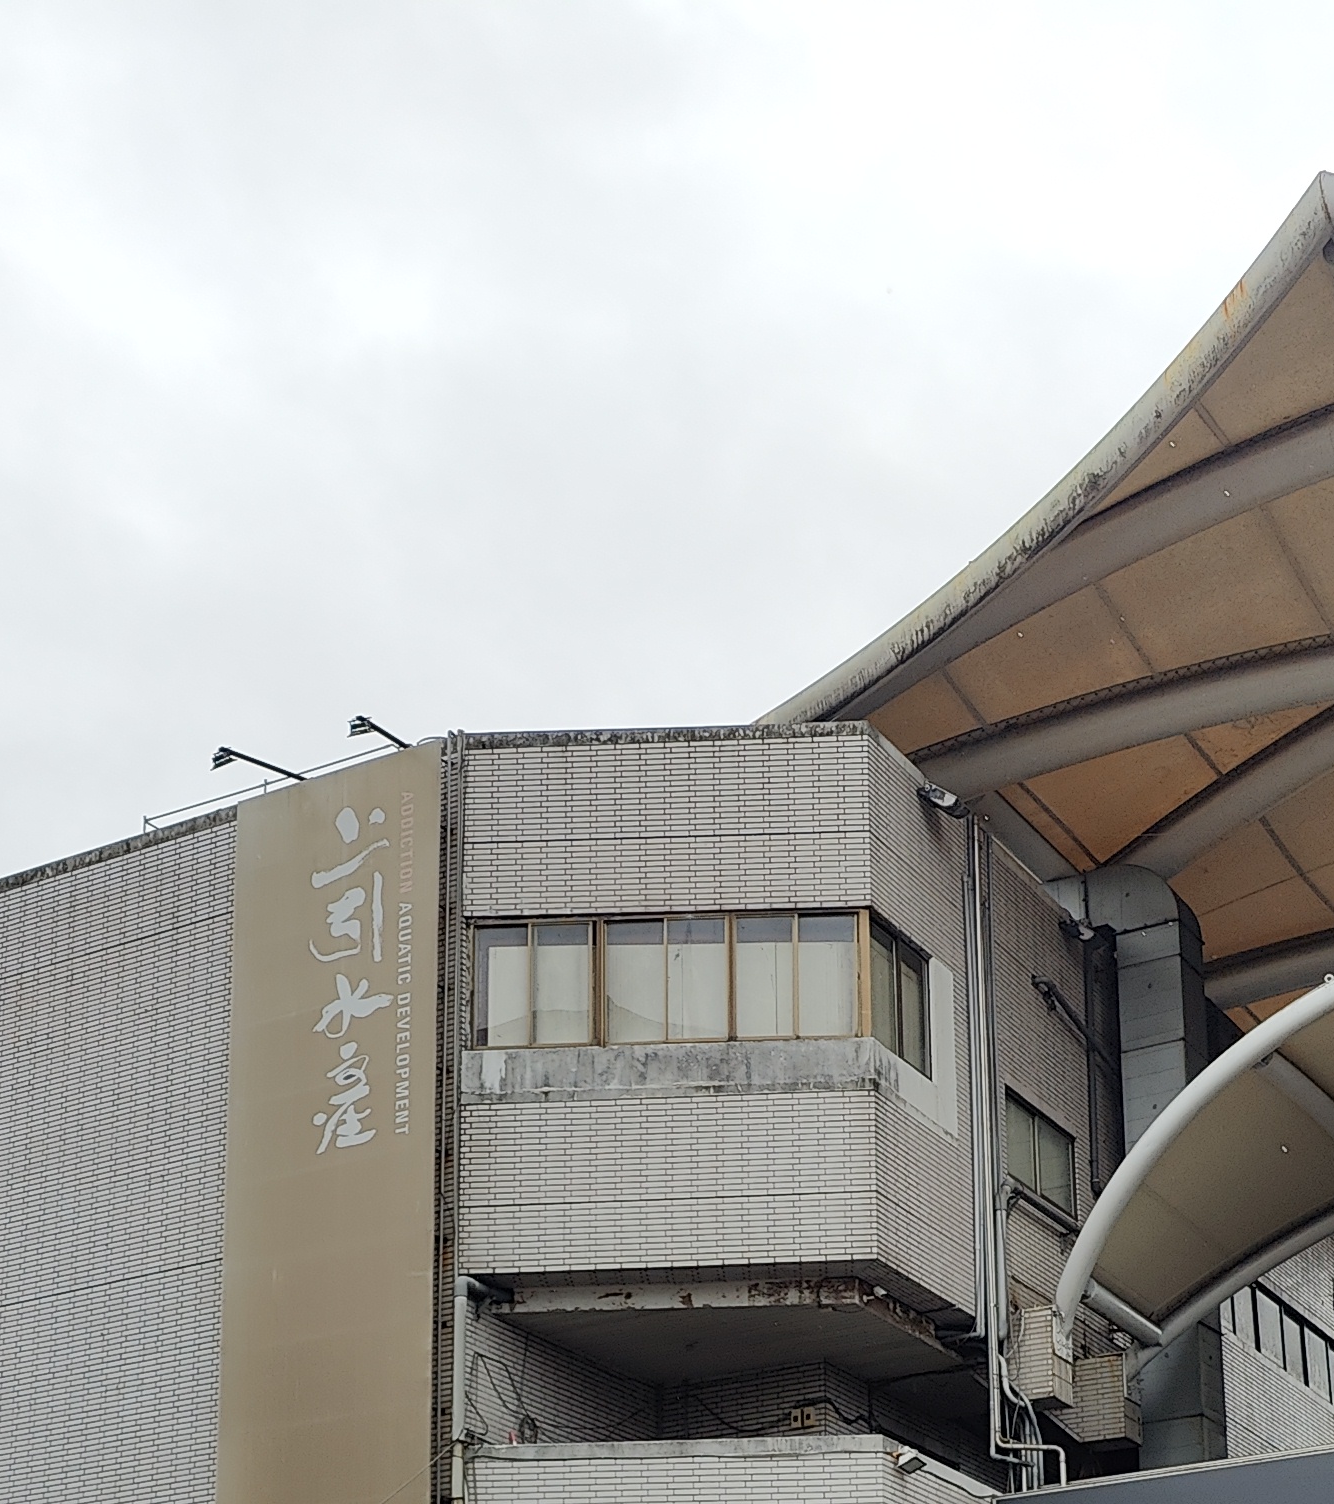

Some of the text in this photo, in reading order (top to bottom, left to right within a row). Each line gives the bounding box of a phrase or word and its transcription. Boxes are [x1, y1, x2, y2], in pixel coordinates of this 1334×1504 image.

[394, 791, 415, 1136] ADDICTION AQUATIC DEVELOPMENT
